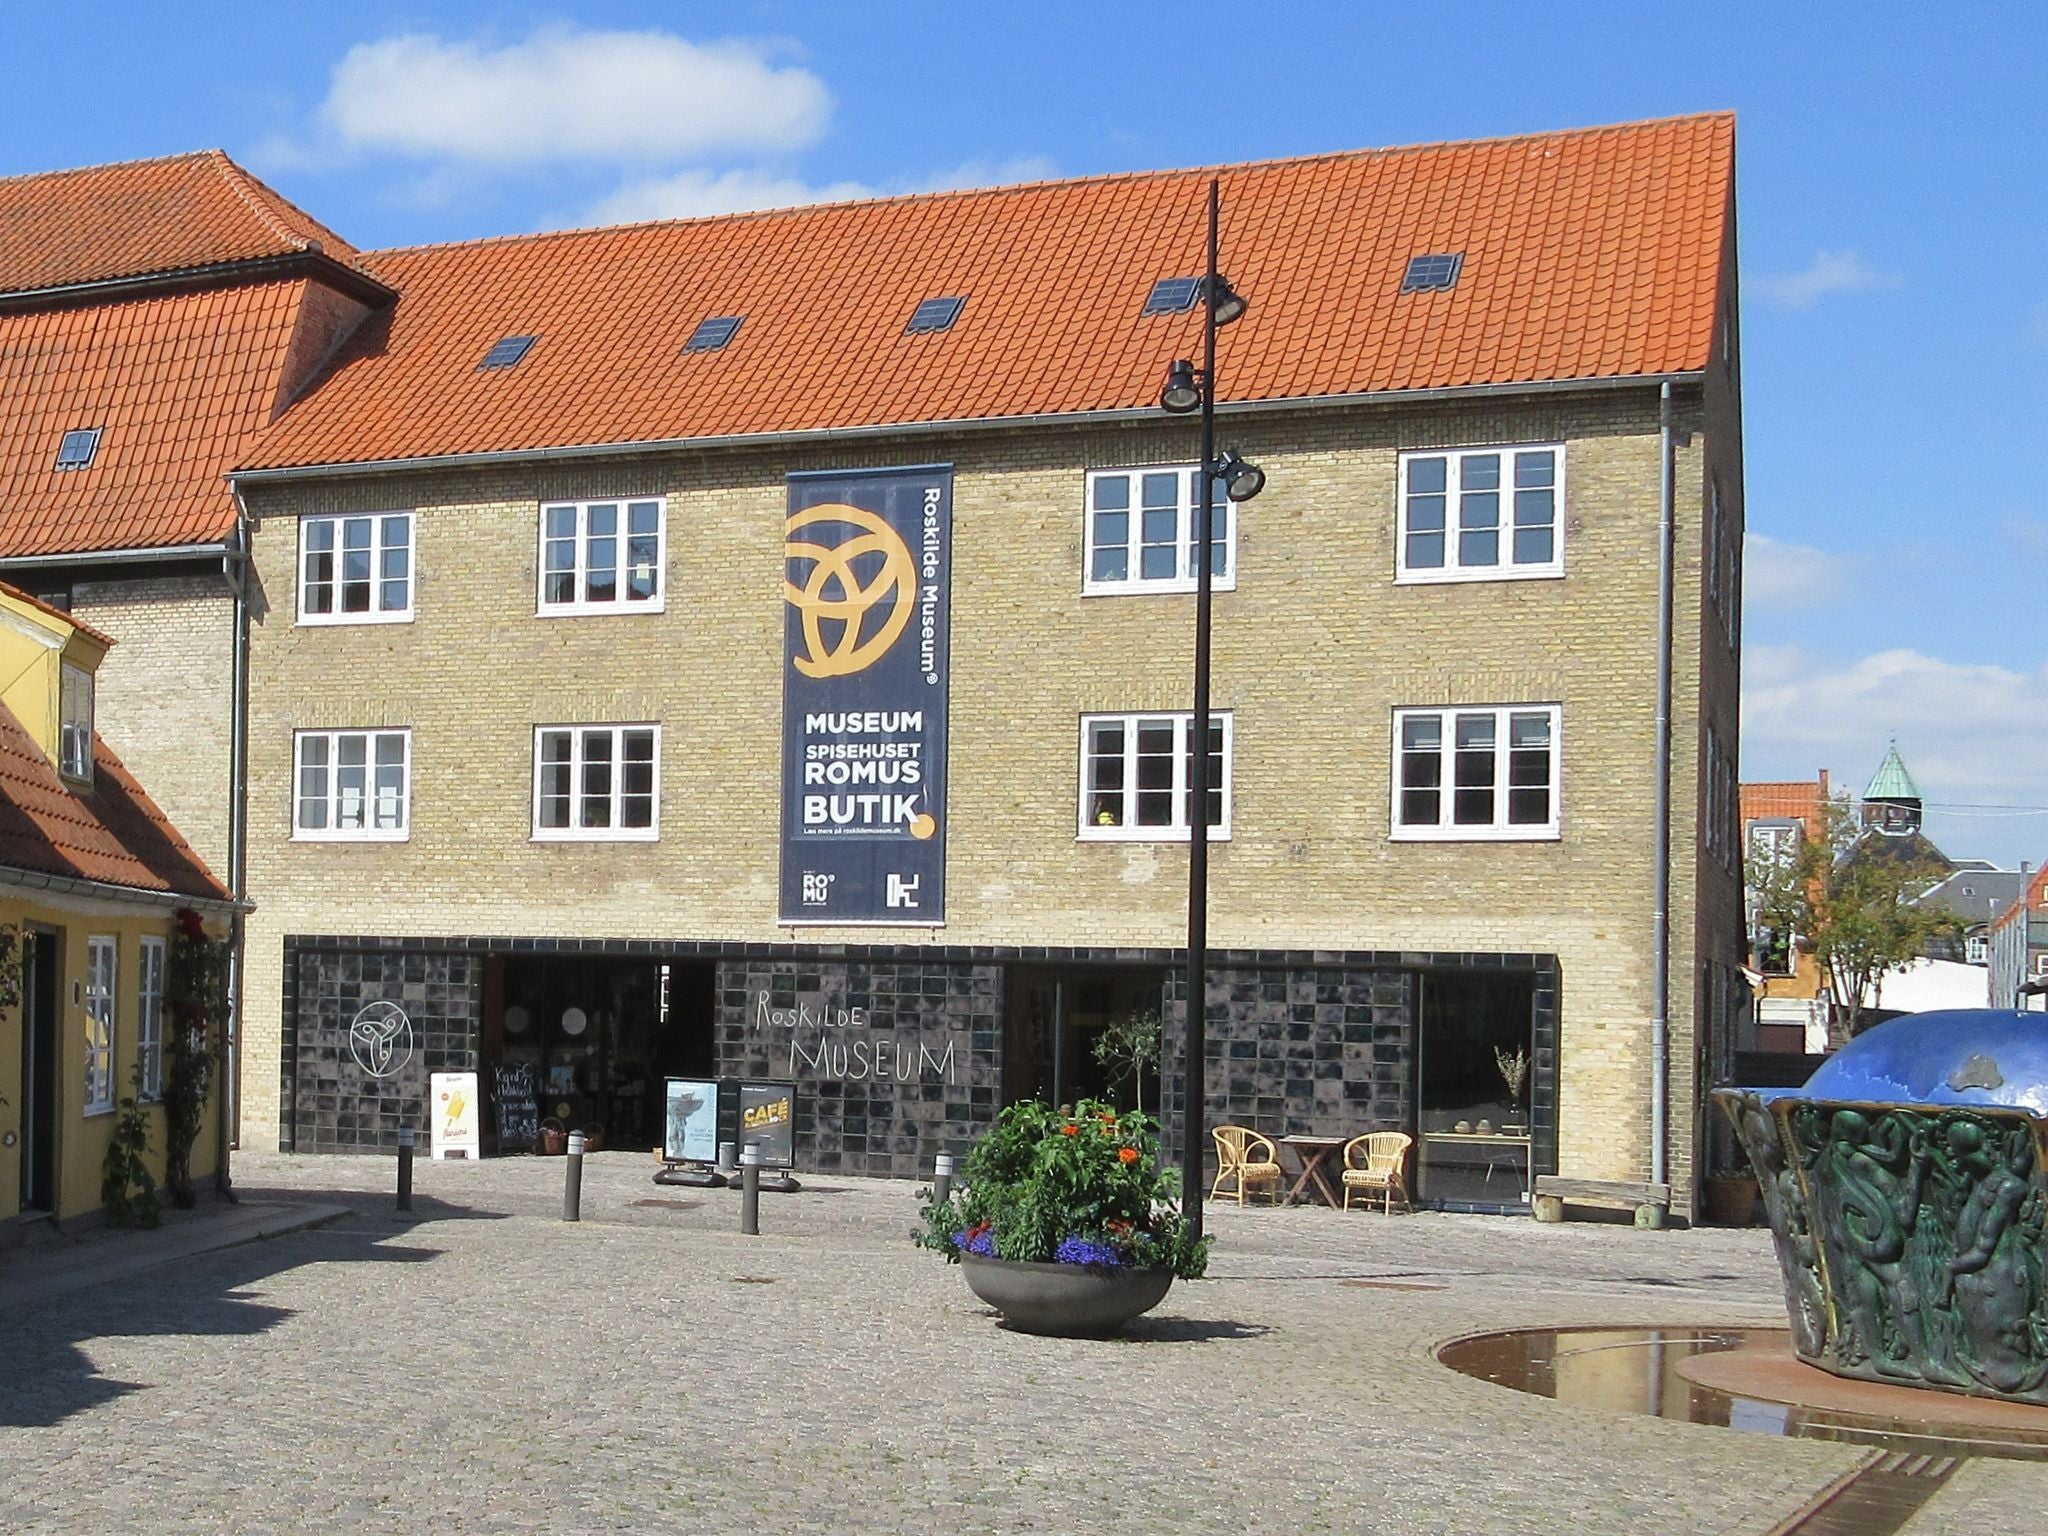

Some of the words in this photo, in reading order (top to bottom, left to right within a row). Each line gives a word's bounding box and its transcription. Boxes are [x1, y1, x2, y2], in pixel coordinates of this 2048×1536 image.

[922, 488, 940, 579] Roskilde
[805, 711, 922, 734] MUSEUM
[806, 743, 921, 760] SPISEHUSET
[805, 760, 921, 785] ROMUS
[803, 794, 920, 824] BUTIK
[789, 1037, 955, 1085] MUSEUM
[743, 1097, 789, 1122] CAFÉ
